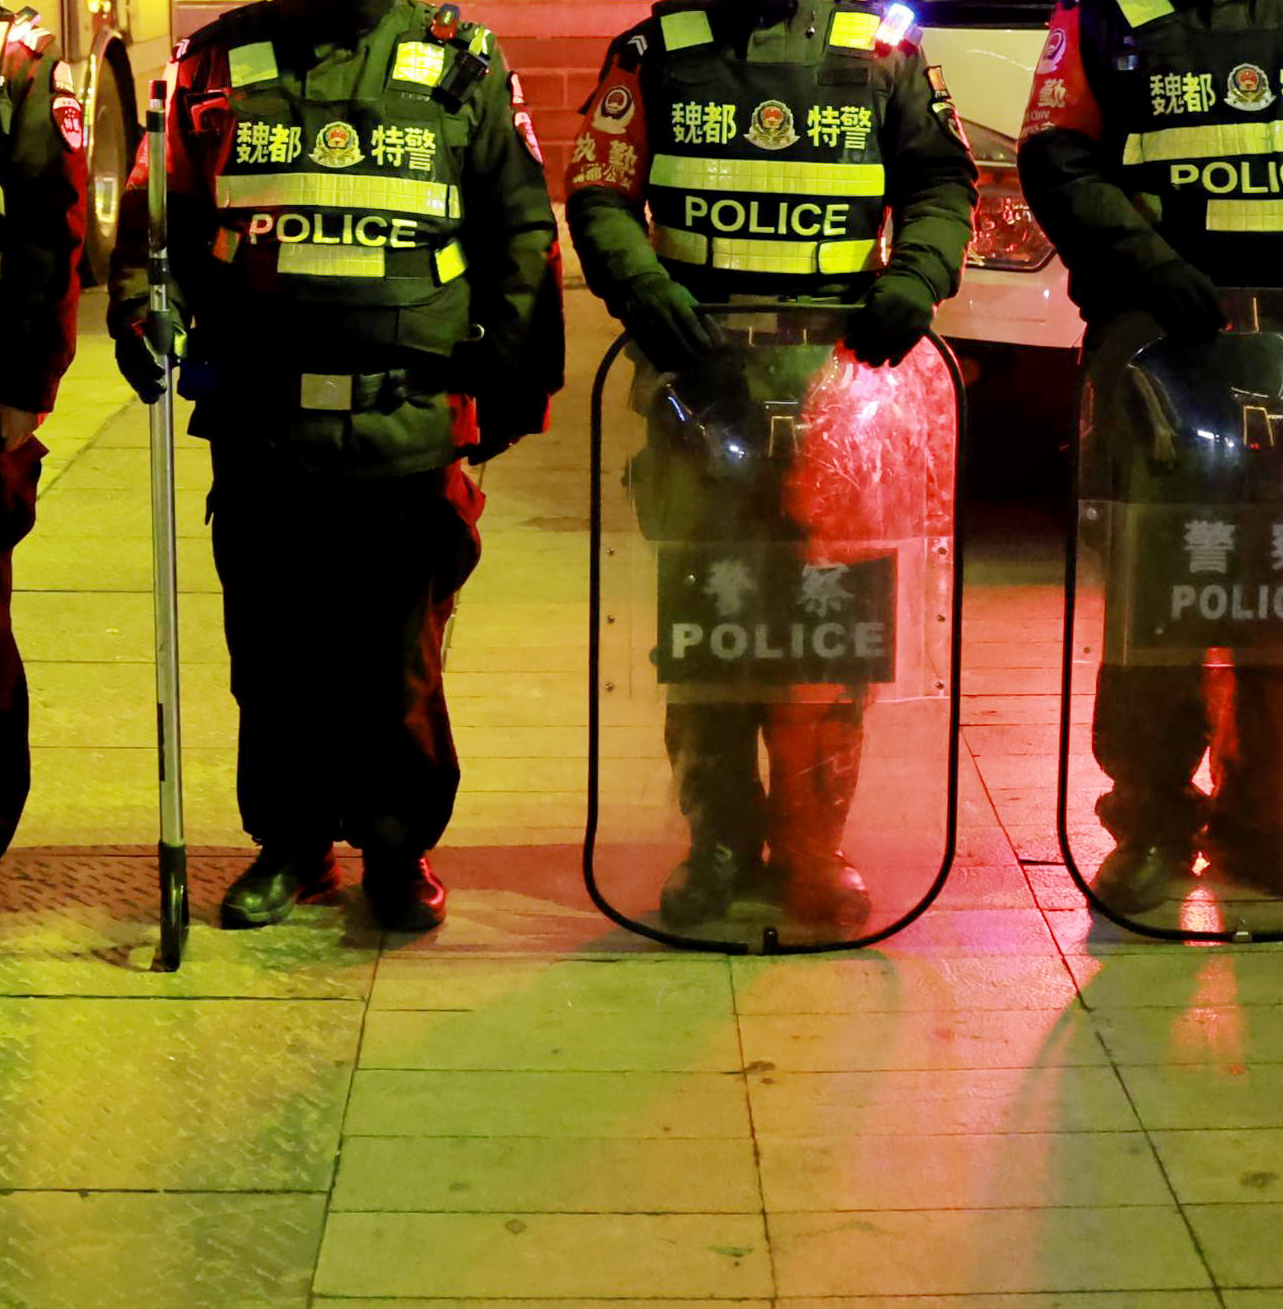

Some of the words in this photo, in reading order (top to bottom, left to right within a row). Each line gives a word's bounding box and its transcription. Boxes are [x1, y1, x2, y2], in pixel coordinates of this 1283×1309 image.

[1150, 73, 1215, 116] 魏都
[236, 122, 301, 164] 魏都
[371, 124, 436, 172] 特警
[672, 101, 736, 145] 魏都
[807, 106, 871, 151] 特警
[249, 213, 418, 248] POLICE
[685, 195, 850, 236] POLICE
[672, 622, 885, 659] POLICE
